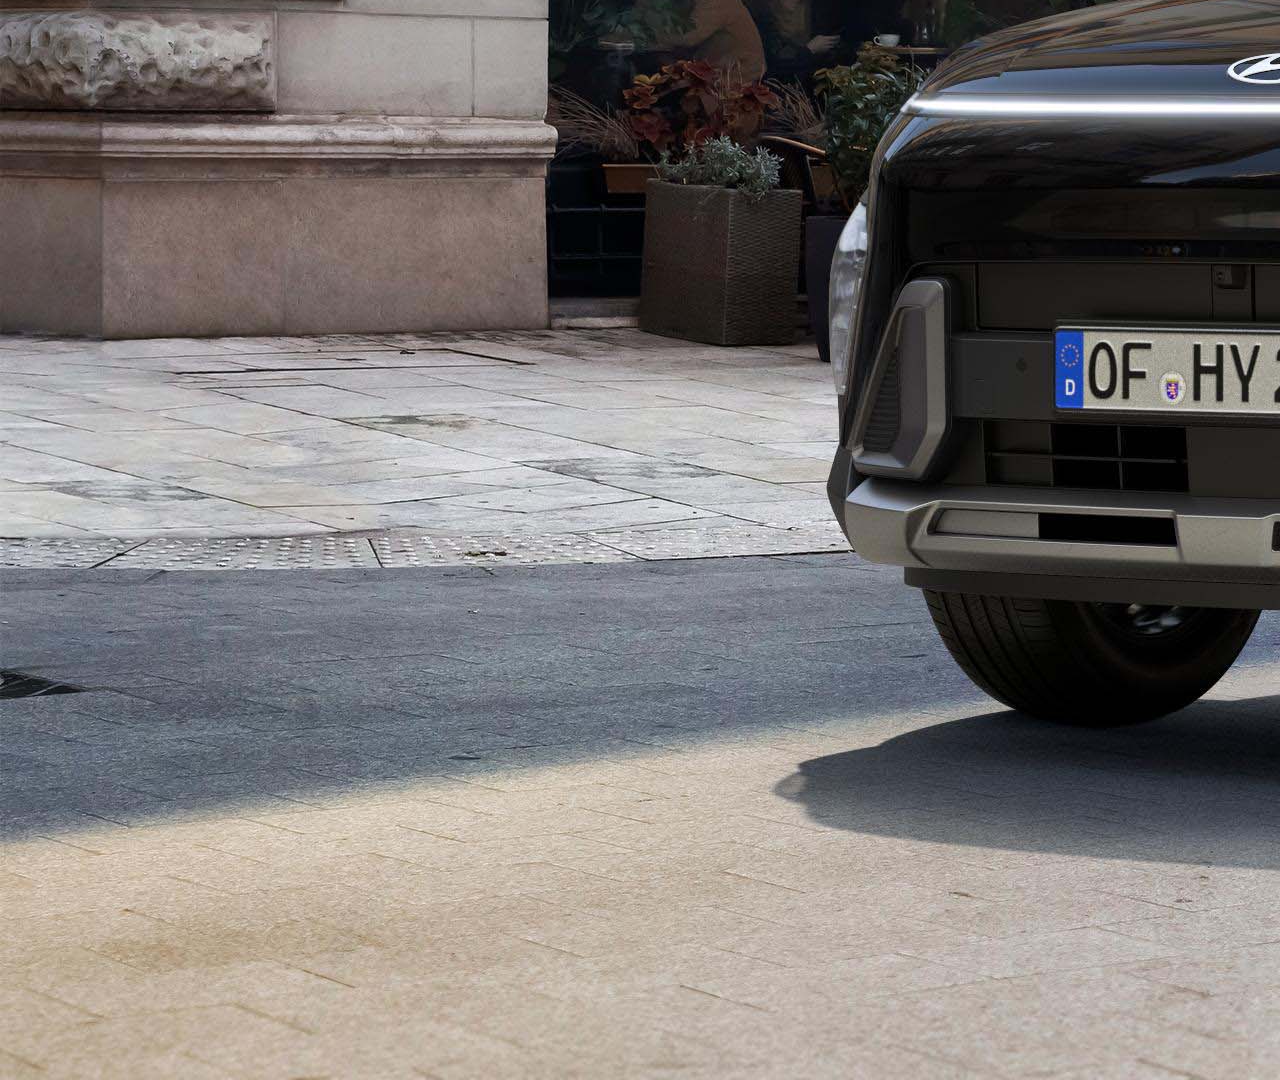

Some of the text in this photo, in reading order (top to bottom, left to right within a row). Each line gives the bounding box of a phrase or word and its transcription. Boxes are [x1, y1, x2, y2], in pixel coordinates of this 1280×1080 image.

[1064, 378, 1076, 396] D
[1088, 341, 1152, 400] OF
[1193, 343, 1261, 403] HY
